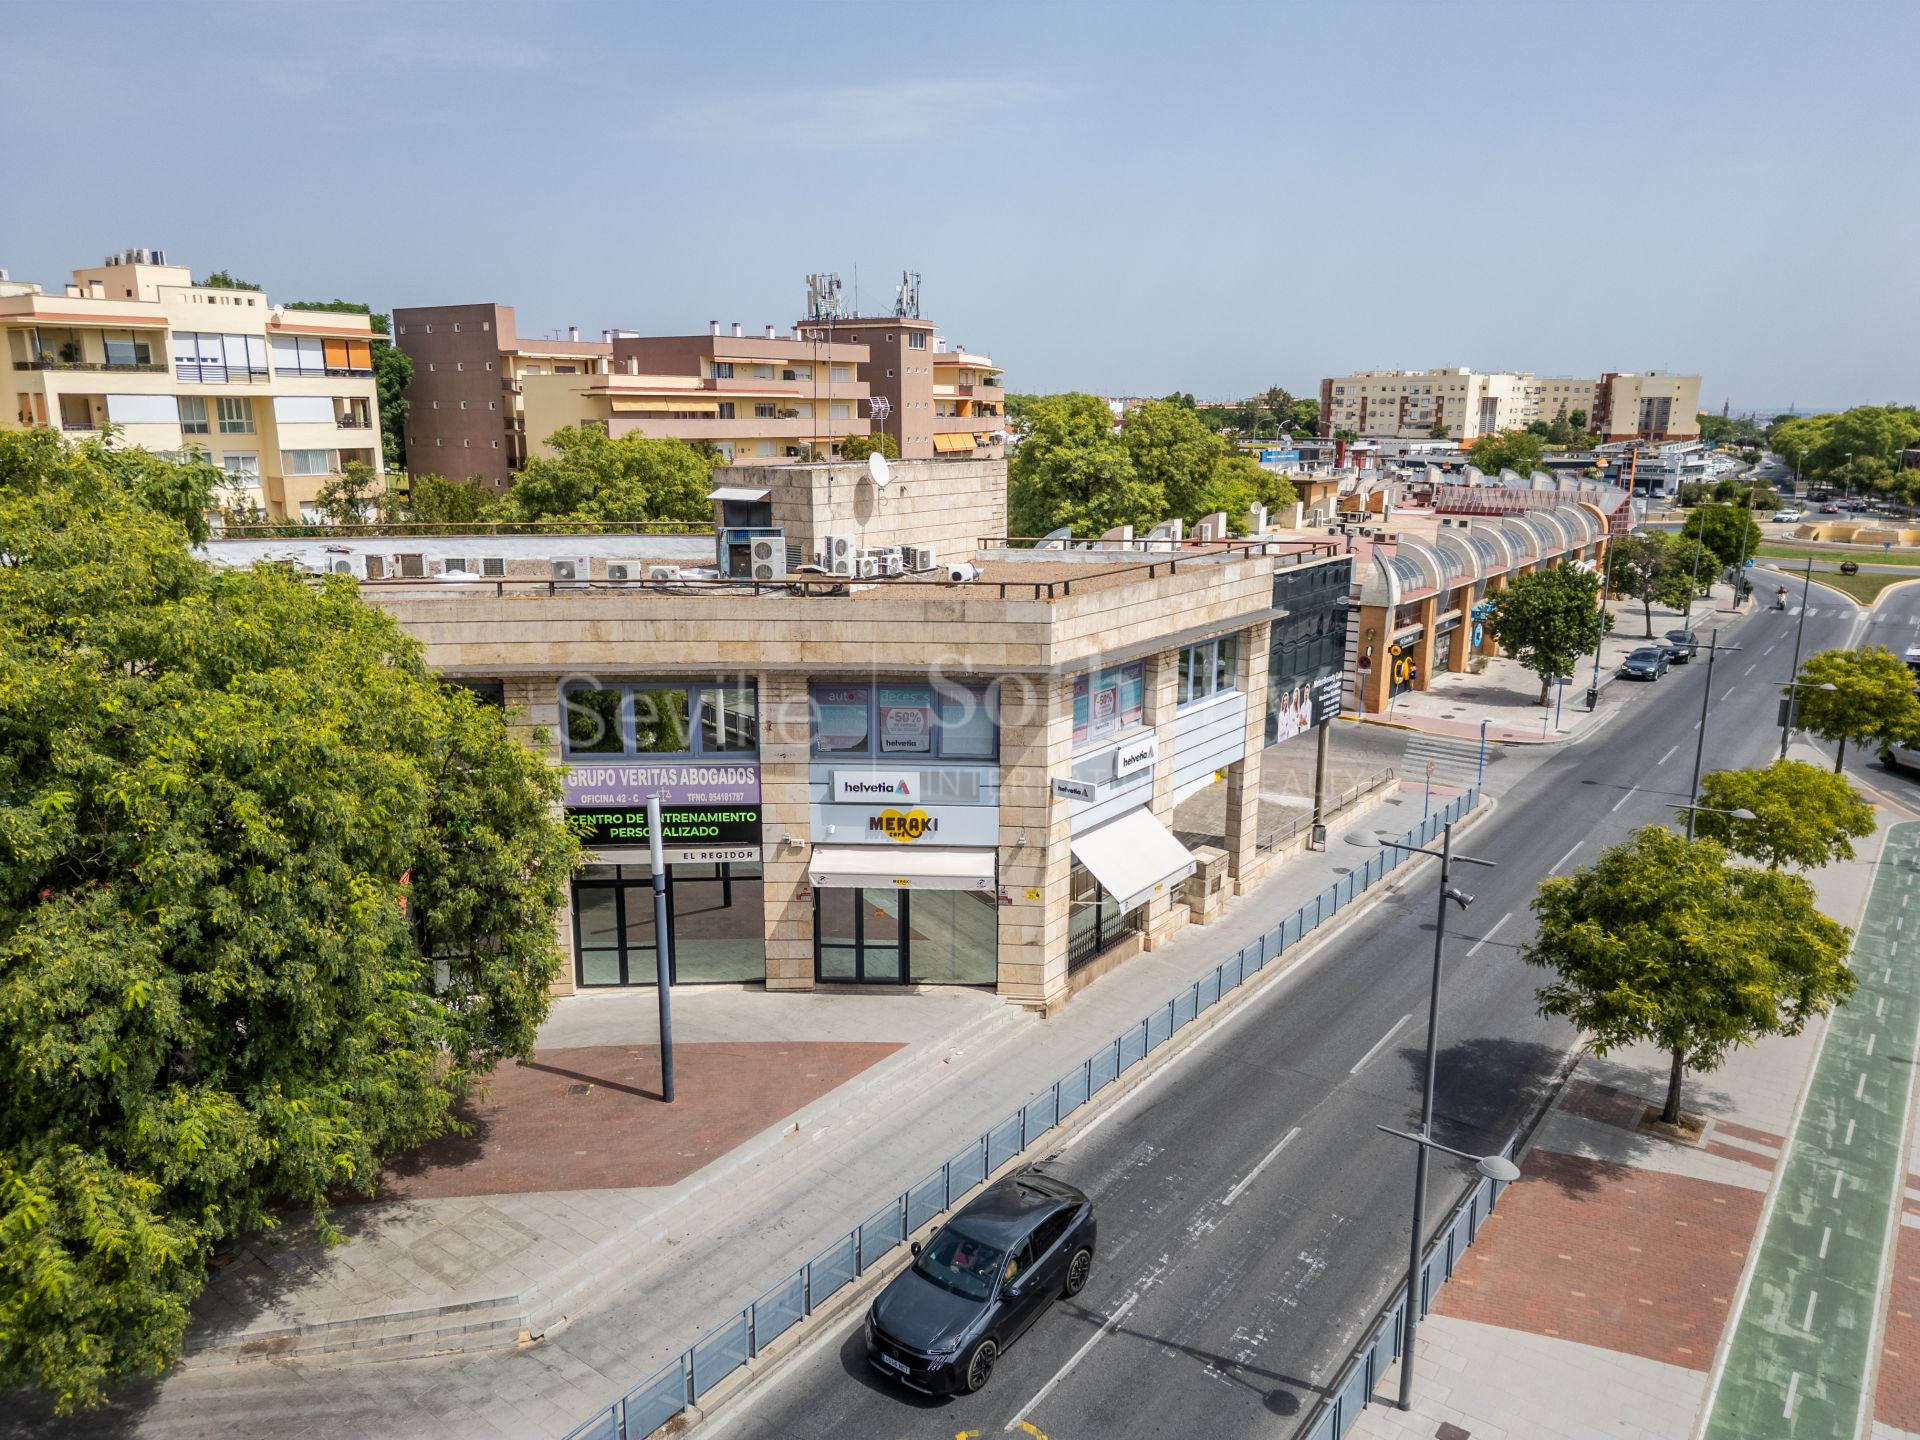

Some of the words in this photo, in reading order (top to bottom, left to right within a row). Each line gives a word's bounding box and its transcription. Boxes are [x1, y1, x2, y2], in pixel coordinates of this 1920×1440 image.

[889, 711, 922, 723] -50%
[886, 739, 917, 747] helvetia
[1123, 750, 1148, 768] helvetia
[567, 768, 616, 787] GRUPO
[619, 768, 677, 786] VERITAS
[680, 767, 755, 785] ABOGADOS
[844, 781, 894, 793] helvetia
[1057, 785, 1082, 796] helvetia
[581, 794, 615, 804] OFICINA
[616, 793, 626, 803] 42
[632, 793, 639, 803] C
[571, 814, 623, 825] CENTRO
[626, 814, 644, 823] DE
[656, 812, 757, 823] NTRENAMIENTO
[610, 826, 719, 838] PERSOALIZADO
[869, 816, 939, 838] MERAKI
[701, 851, 753, 860] REGIDOR
